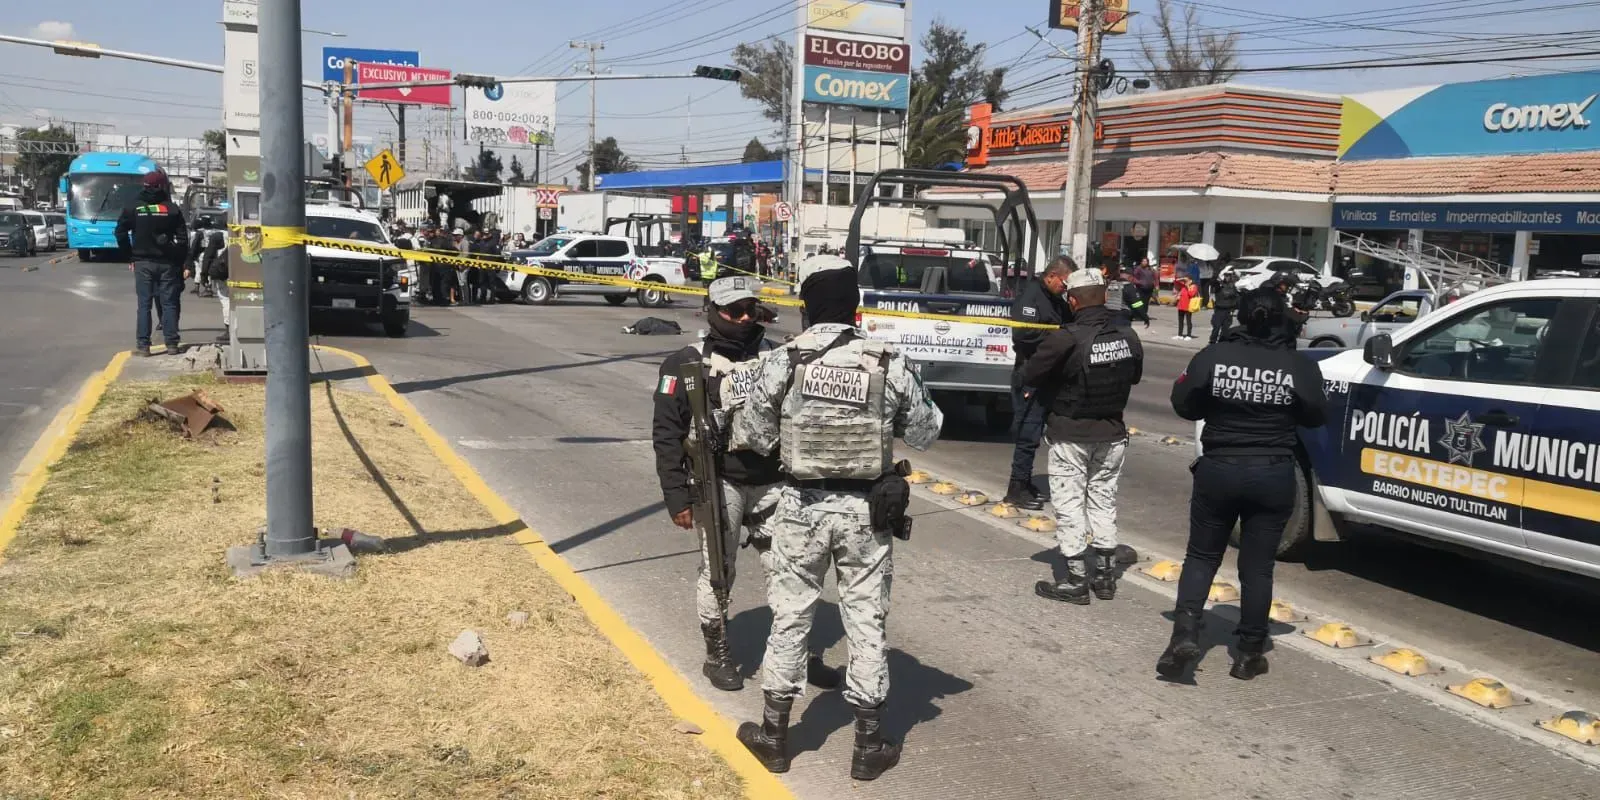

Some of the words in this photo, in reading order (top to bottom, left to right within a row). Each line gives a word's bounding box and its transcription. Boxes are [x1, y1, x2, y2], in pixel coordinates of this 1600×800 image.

[811, 38, 834, 55] EL
[835, 41, 904, 62] GLOBO
[363, 68, 407, 82] EXCLUSIVO
[815, 73, 899, 101] Comex
[1484, 93, 1599, 131] Comex
[989, 125, 1016, 148] Little
[1018, 122, 1062, 145] Caesars
[1389, 209, 1437, 223] Esmaltes
[1446, 209, 1562, 225] Impermeabilizantes
[966, 304, 1013, 318] MUNICIPAL
[936, 336, 965, 348] Sector
[1090, 348, 1133, 364] NACIONAL
[811, 366, 862, 386] GUARDIA
[1213, 377, 1293, 396] MUNICIPAL
[1214, 363, 1295, 388] POLICÍA
[804, 380, 865, 402] NACIONAL
[1212, 387, 1292, 405] ECATEPEC
[1350, 409, 1430, 454] POLICÍA
[1373, 452, 1508, 499] ECATEPEC
[1372, 480, 1410, 499] BARRIO
[1411, 488, 1448, 507] NUEVO
[1448, 496, 1508, 521] TULTITLAN
